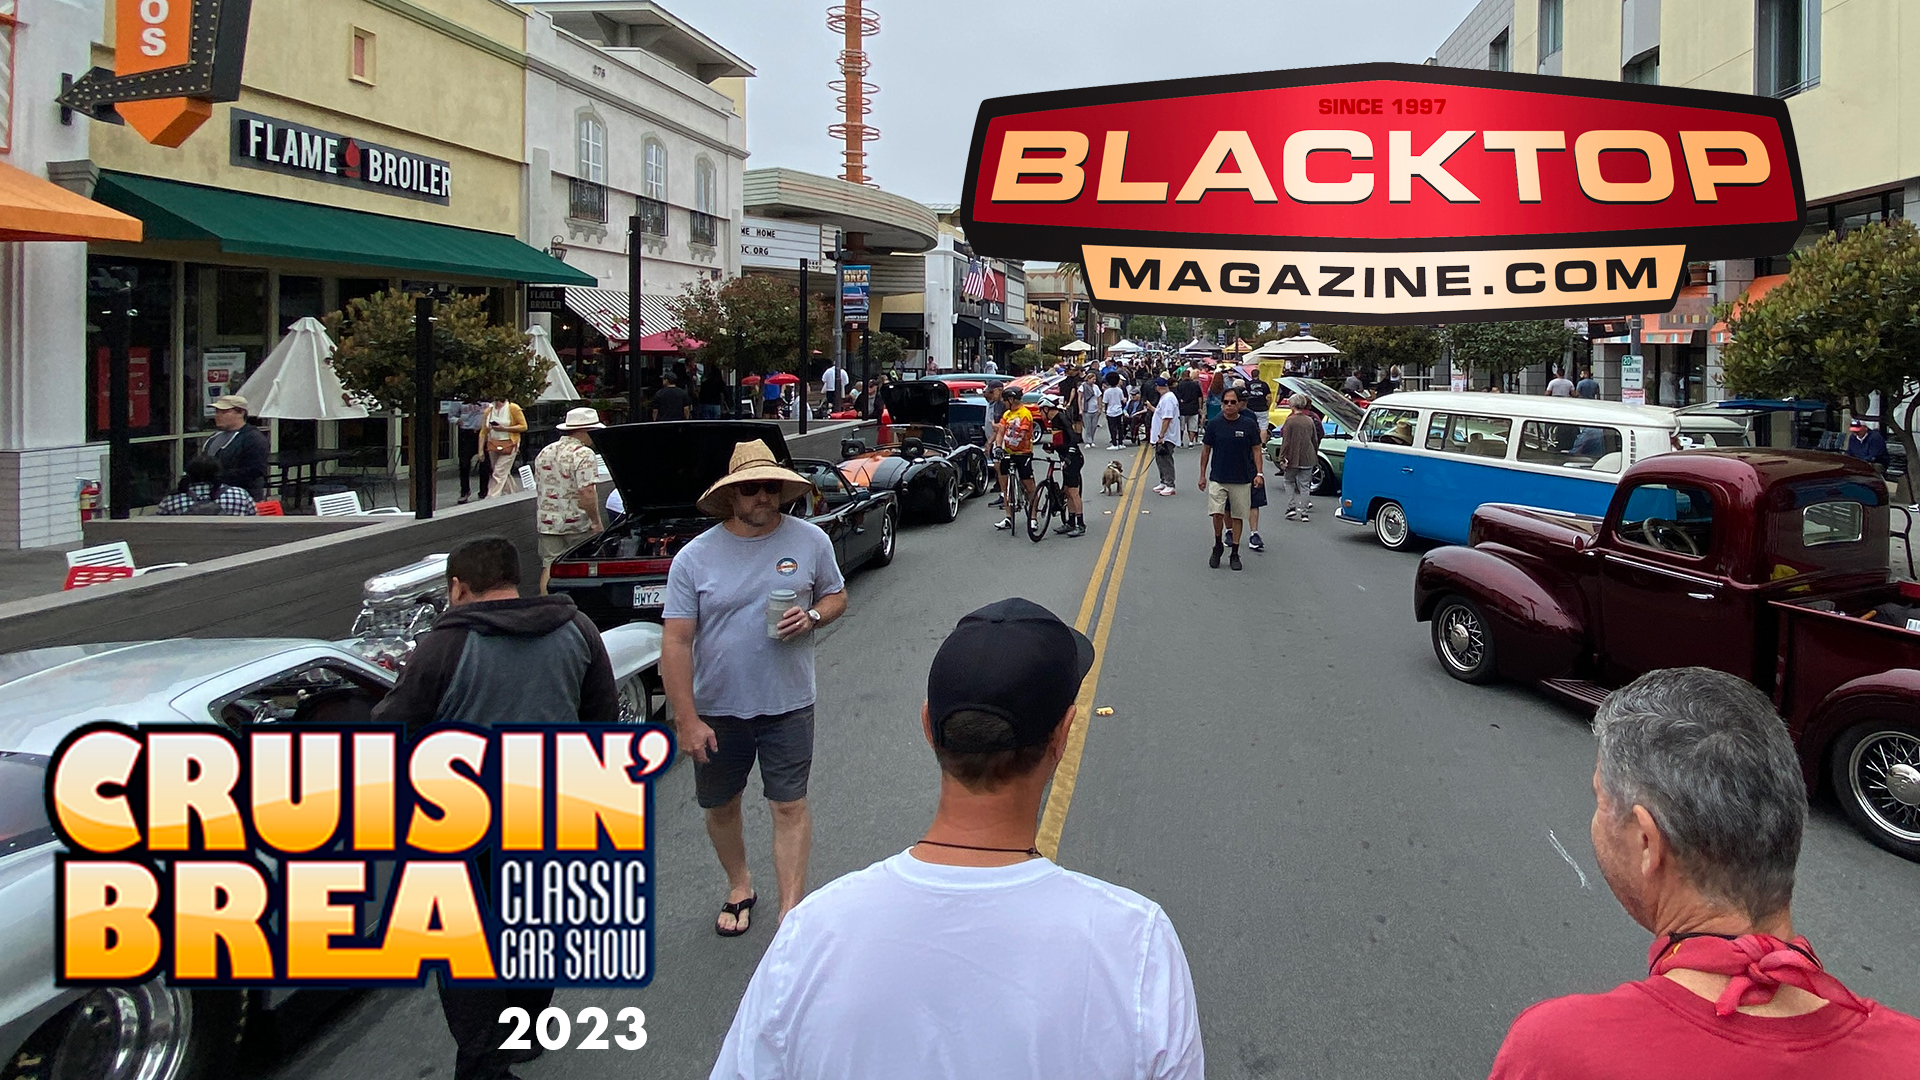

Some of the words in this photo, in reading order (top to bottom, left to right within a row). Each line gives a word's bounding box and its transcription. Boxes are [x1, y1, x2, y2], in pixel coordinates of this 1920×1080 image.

[249, 119, 338, 174] FLAME
[368, 148, 452, 197] BROILER
[756, 229, 776, 238] HOME
[634, 592, 652, 605] HWY
